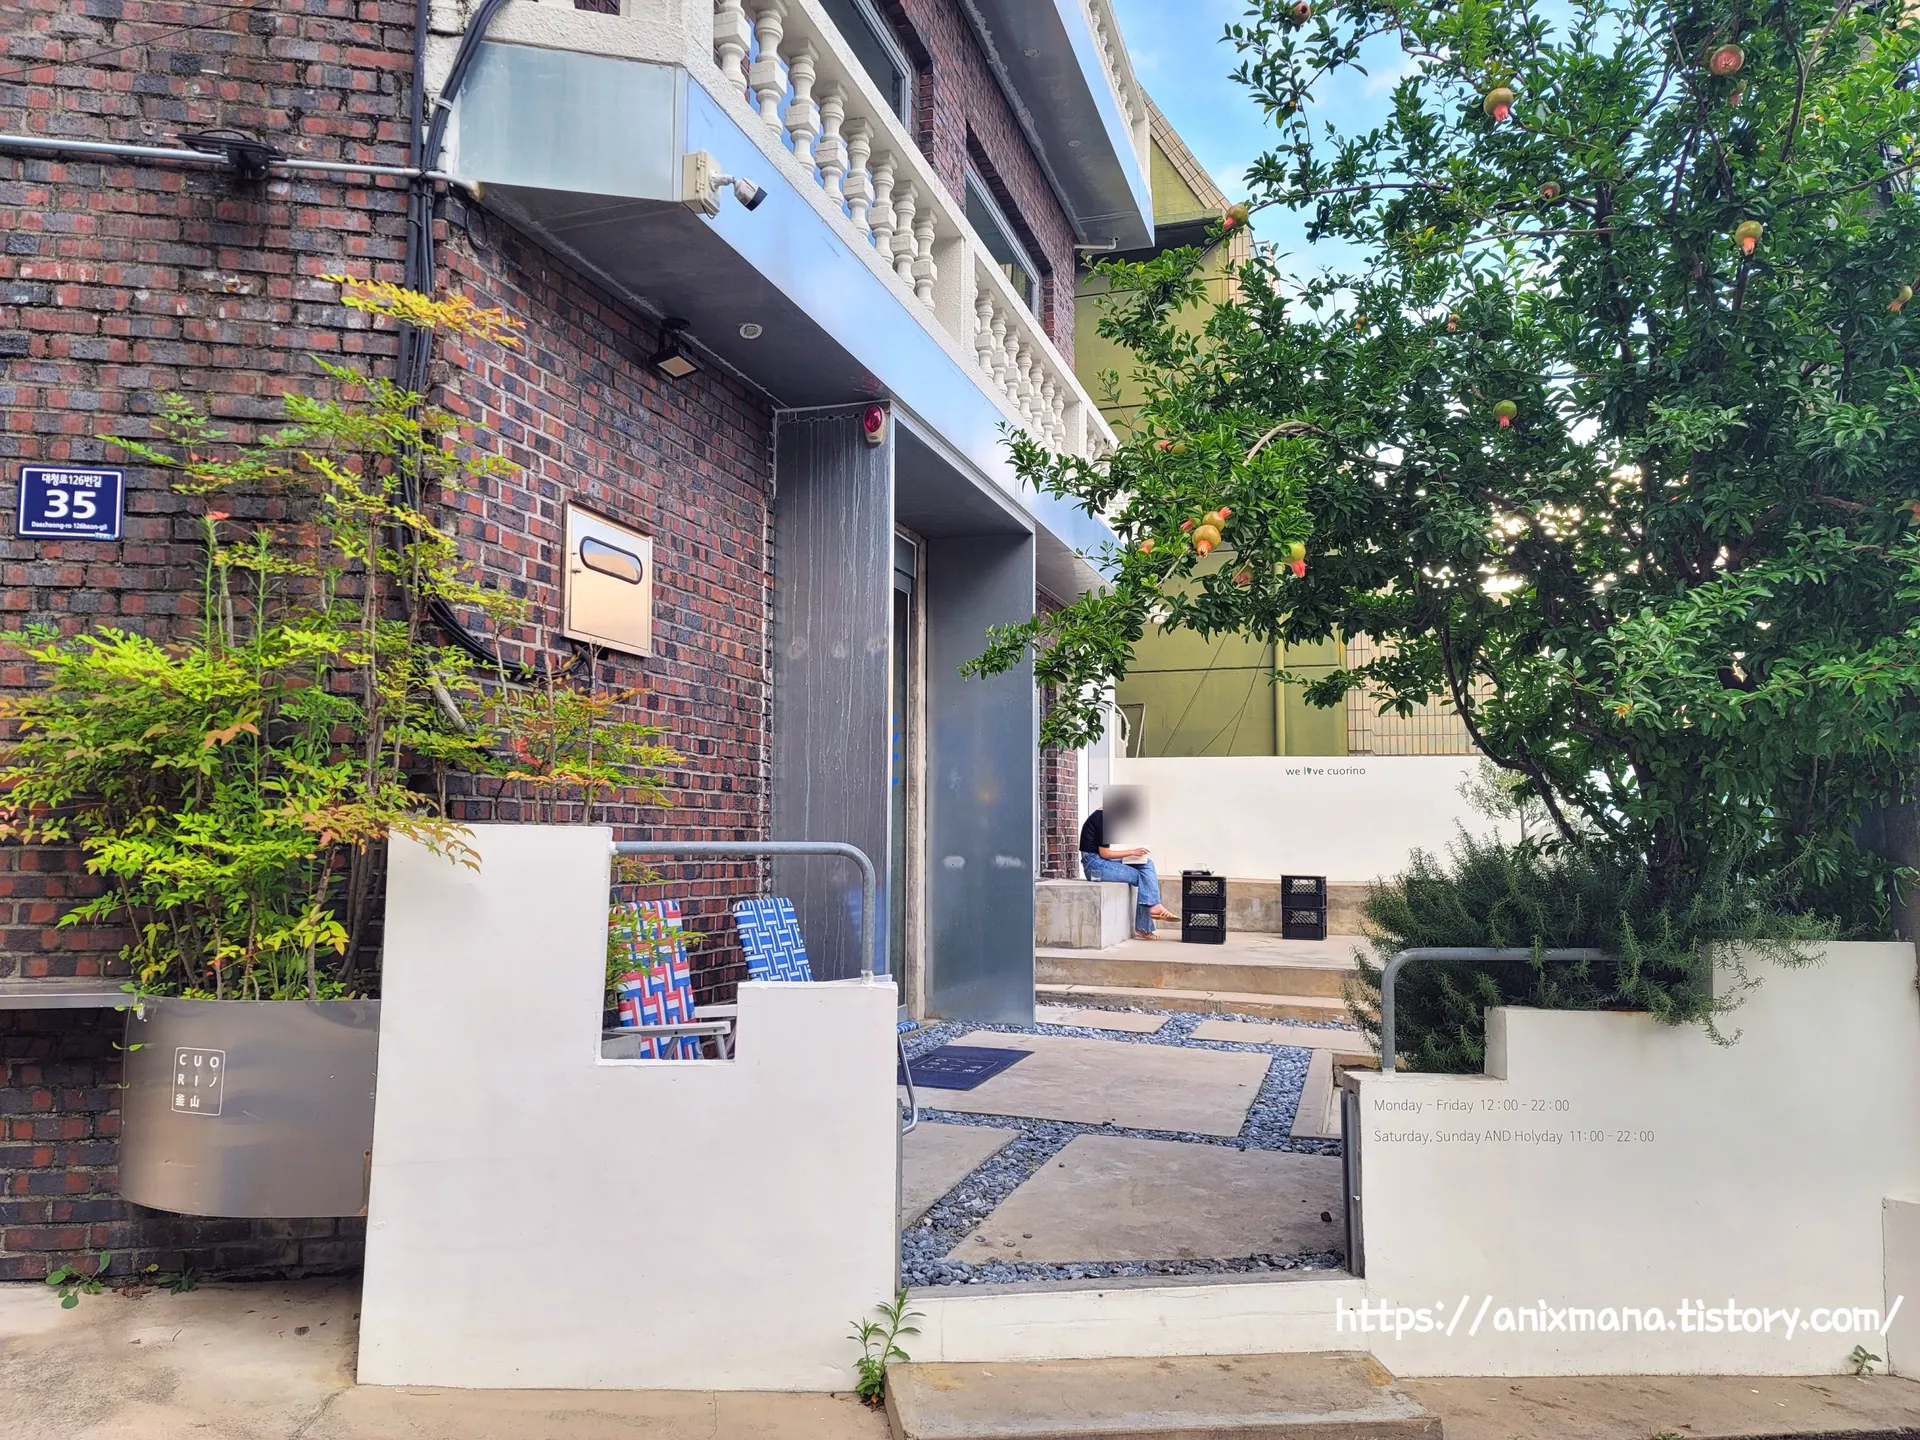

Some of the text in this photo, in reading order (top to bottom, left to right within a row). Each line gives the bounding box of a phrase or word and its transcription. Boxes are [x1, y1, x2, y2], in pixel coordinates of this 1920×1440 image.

[41, 473, 102, 488] 대청로126번길
[44, 489, 97, 519] 35
[1285, 768, 1301, 776] we
[1326, 765, 1366, 776] cuorino
[175, 1093, 200, 1108] 釜山
[1374, 1098, 1423, 1114] Monday
[1436, 1098, 1474, 1114] Friday
[1373, 1129, 1433, 1145] Saturday,
[1435, 1129, 1481, 1145] Sunday
[1484, 1130, 1512, 1142] AND
[1514, 1129, 1564, 1145] Holyday
